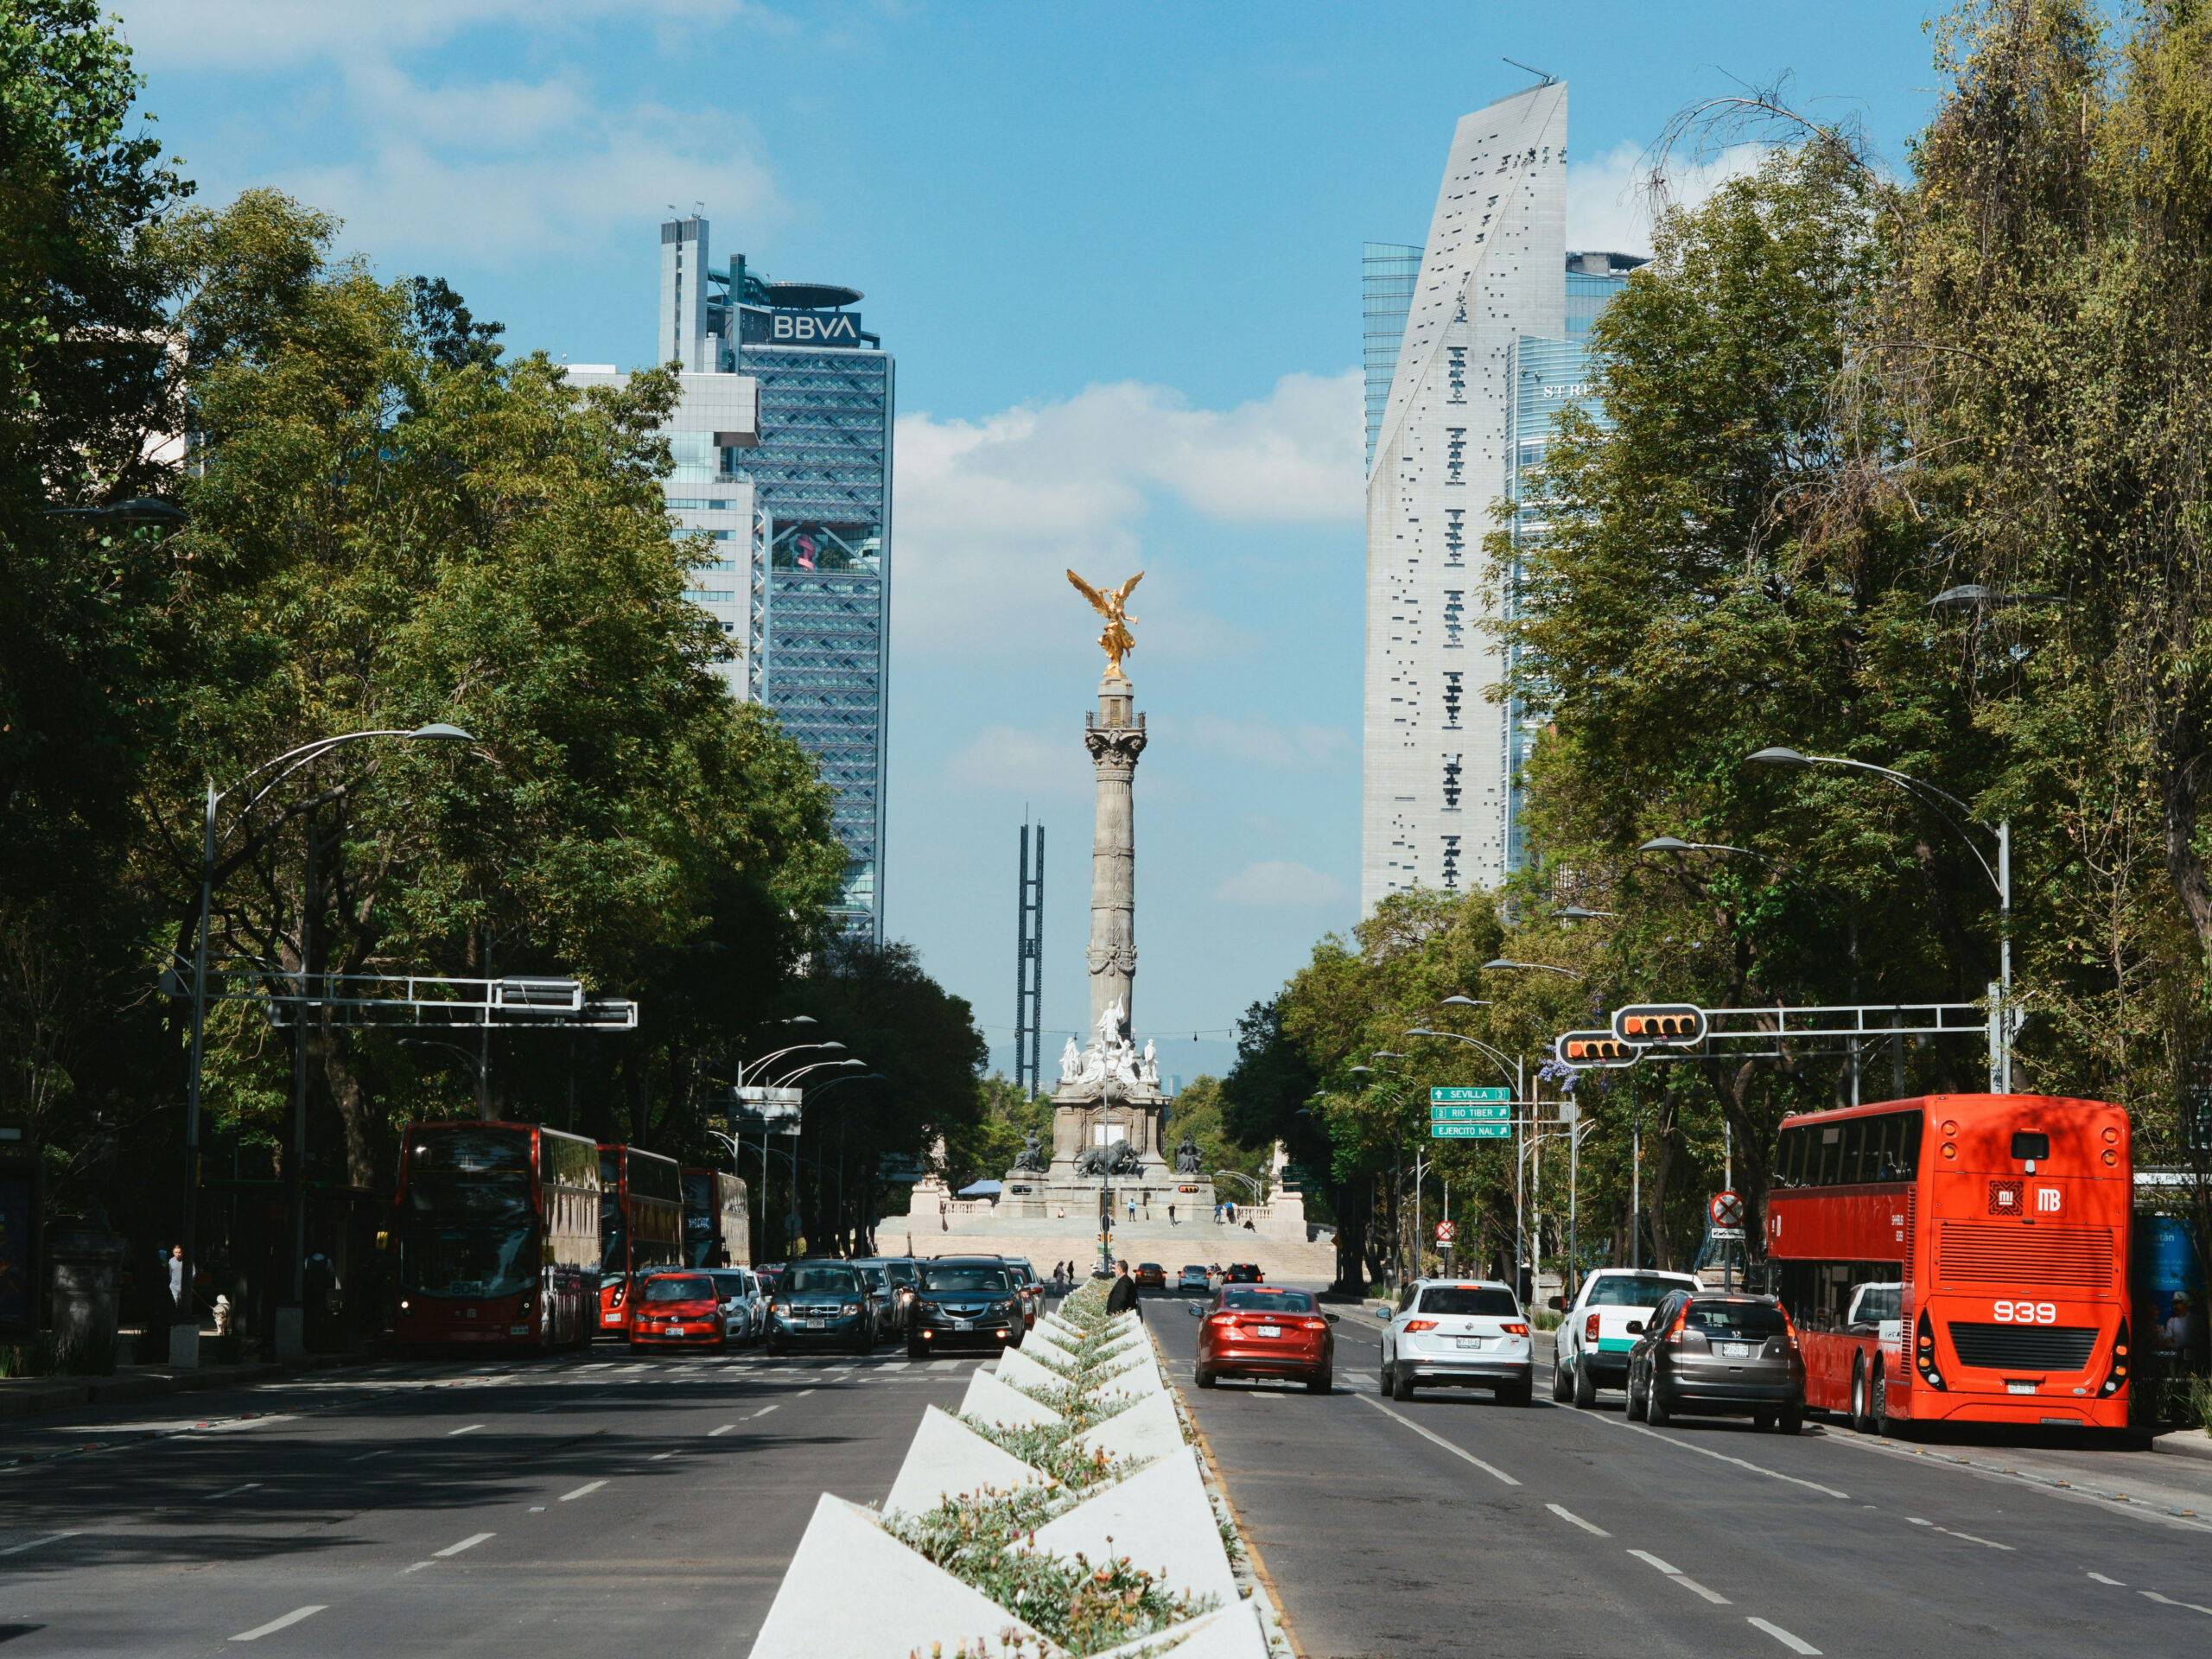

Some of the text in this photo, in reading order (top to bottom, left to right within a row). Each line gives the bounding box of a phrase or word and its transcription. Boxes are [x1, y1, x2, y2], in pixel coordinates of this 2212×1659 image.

[774, 315, 857, 340] BBVA
[1497, 1090, 1503, 1098] 3
[1452, 1109, 1465, 1117] RIO
[1470, 1109, 1493, 1117] TIBER
[1439, 1127, 1495, 1135] EJERCITO NAL
[452, 1282, 479, 1294] 804
[1993, 1300, 2056, 1324] 939
